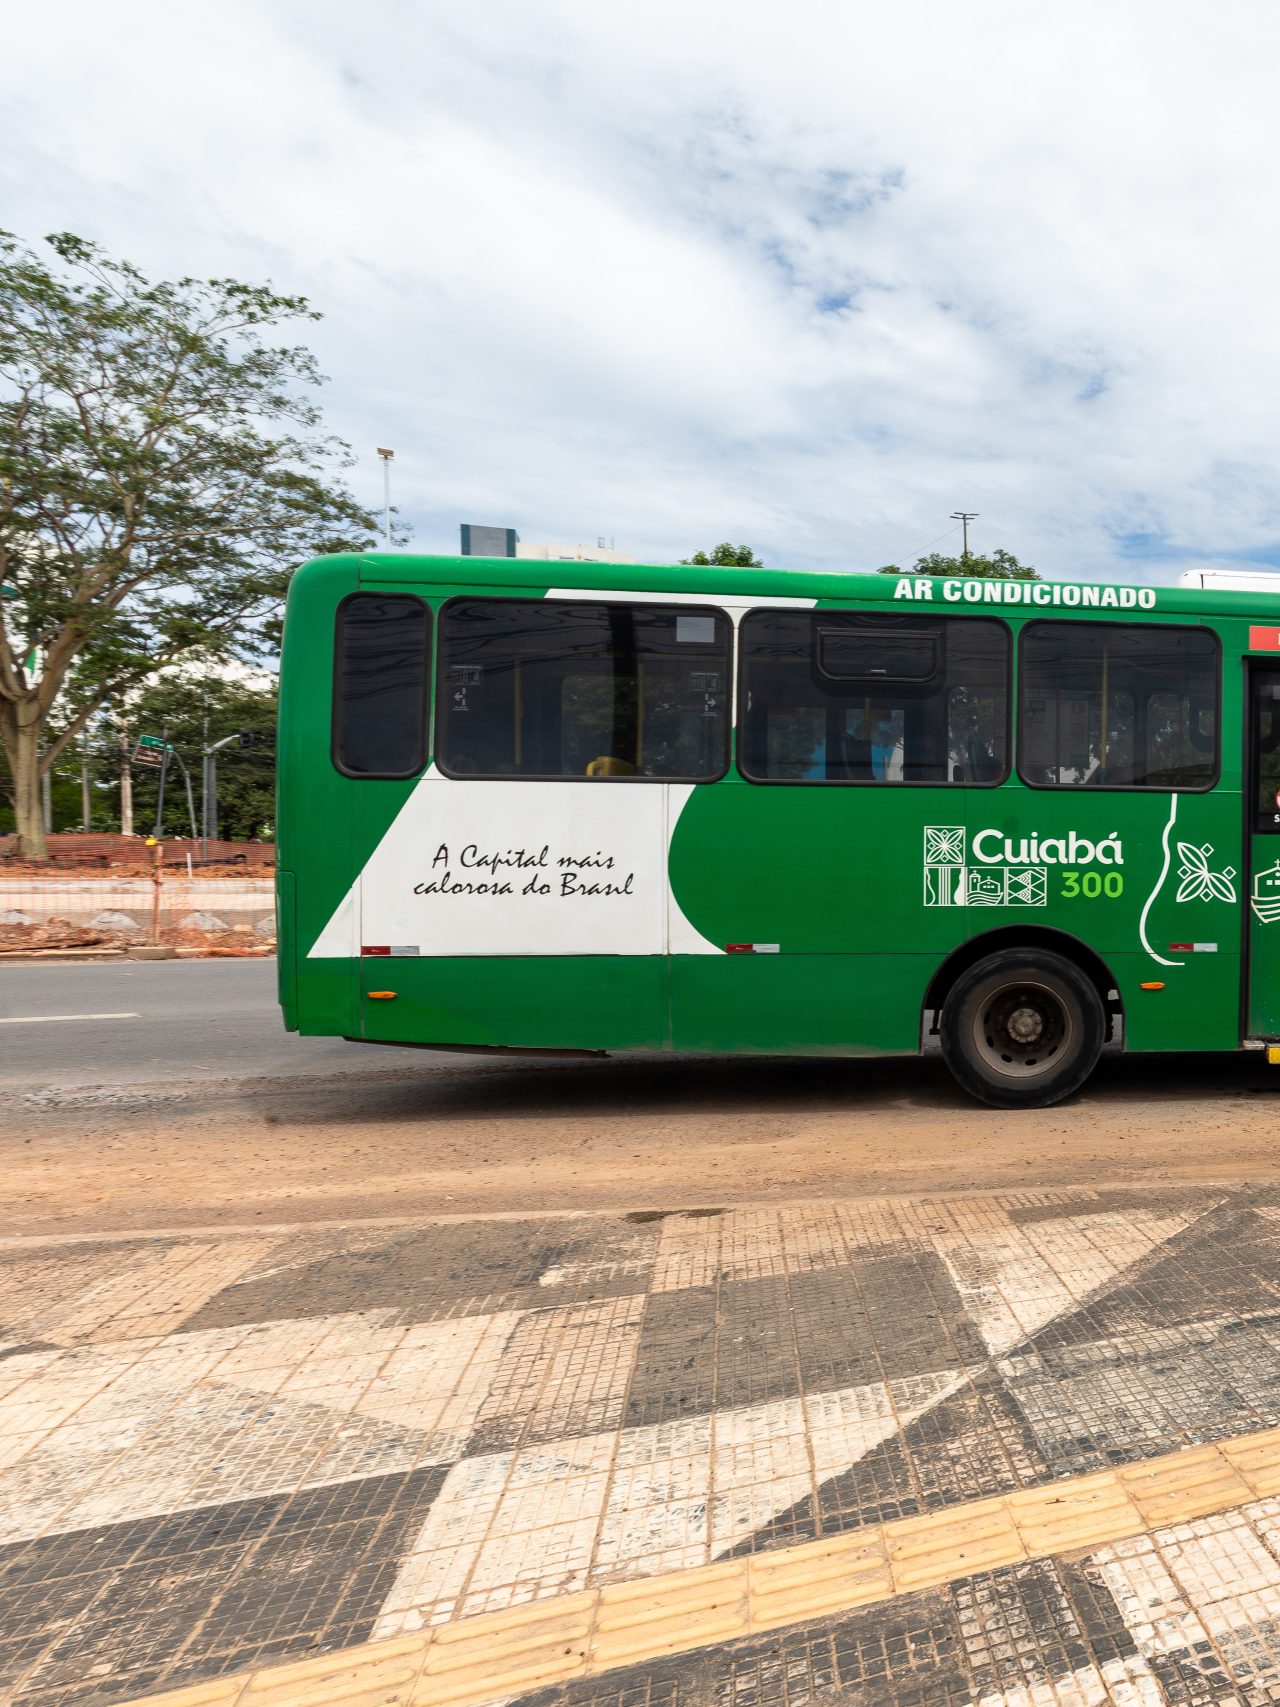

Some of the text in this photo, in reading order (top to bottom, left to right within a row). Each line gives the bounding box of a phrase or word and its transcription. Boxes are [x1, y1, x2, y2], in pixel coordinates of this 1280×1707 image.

[893, 578, 1157, 609] AR CONDICIONADO
[432, 843, 615, 876] A Capital mais
[972, 828, 1124, 864] Cuiabá
[413, 871, 514, 896] calorosa
[521, 873, 551, 896] do
[1061, 871, 1124, 898] 300
